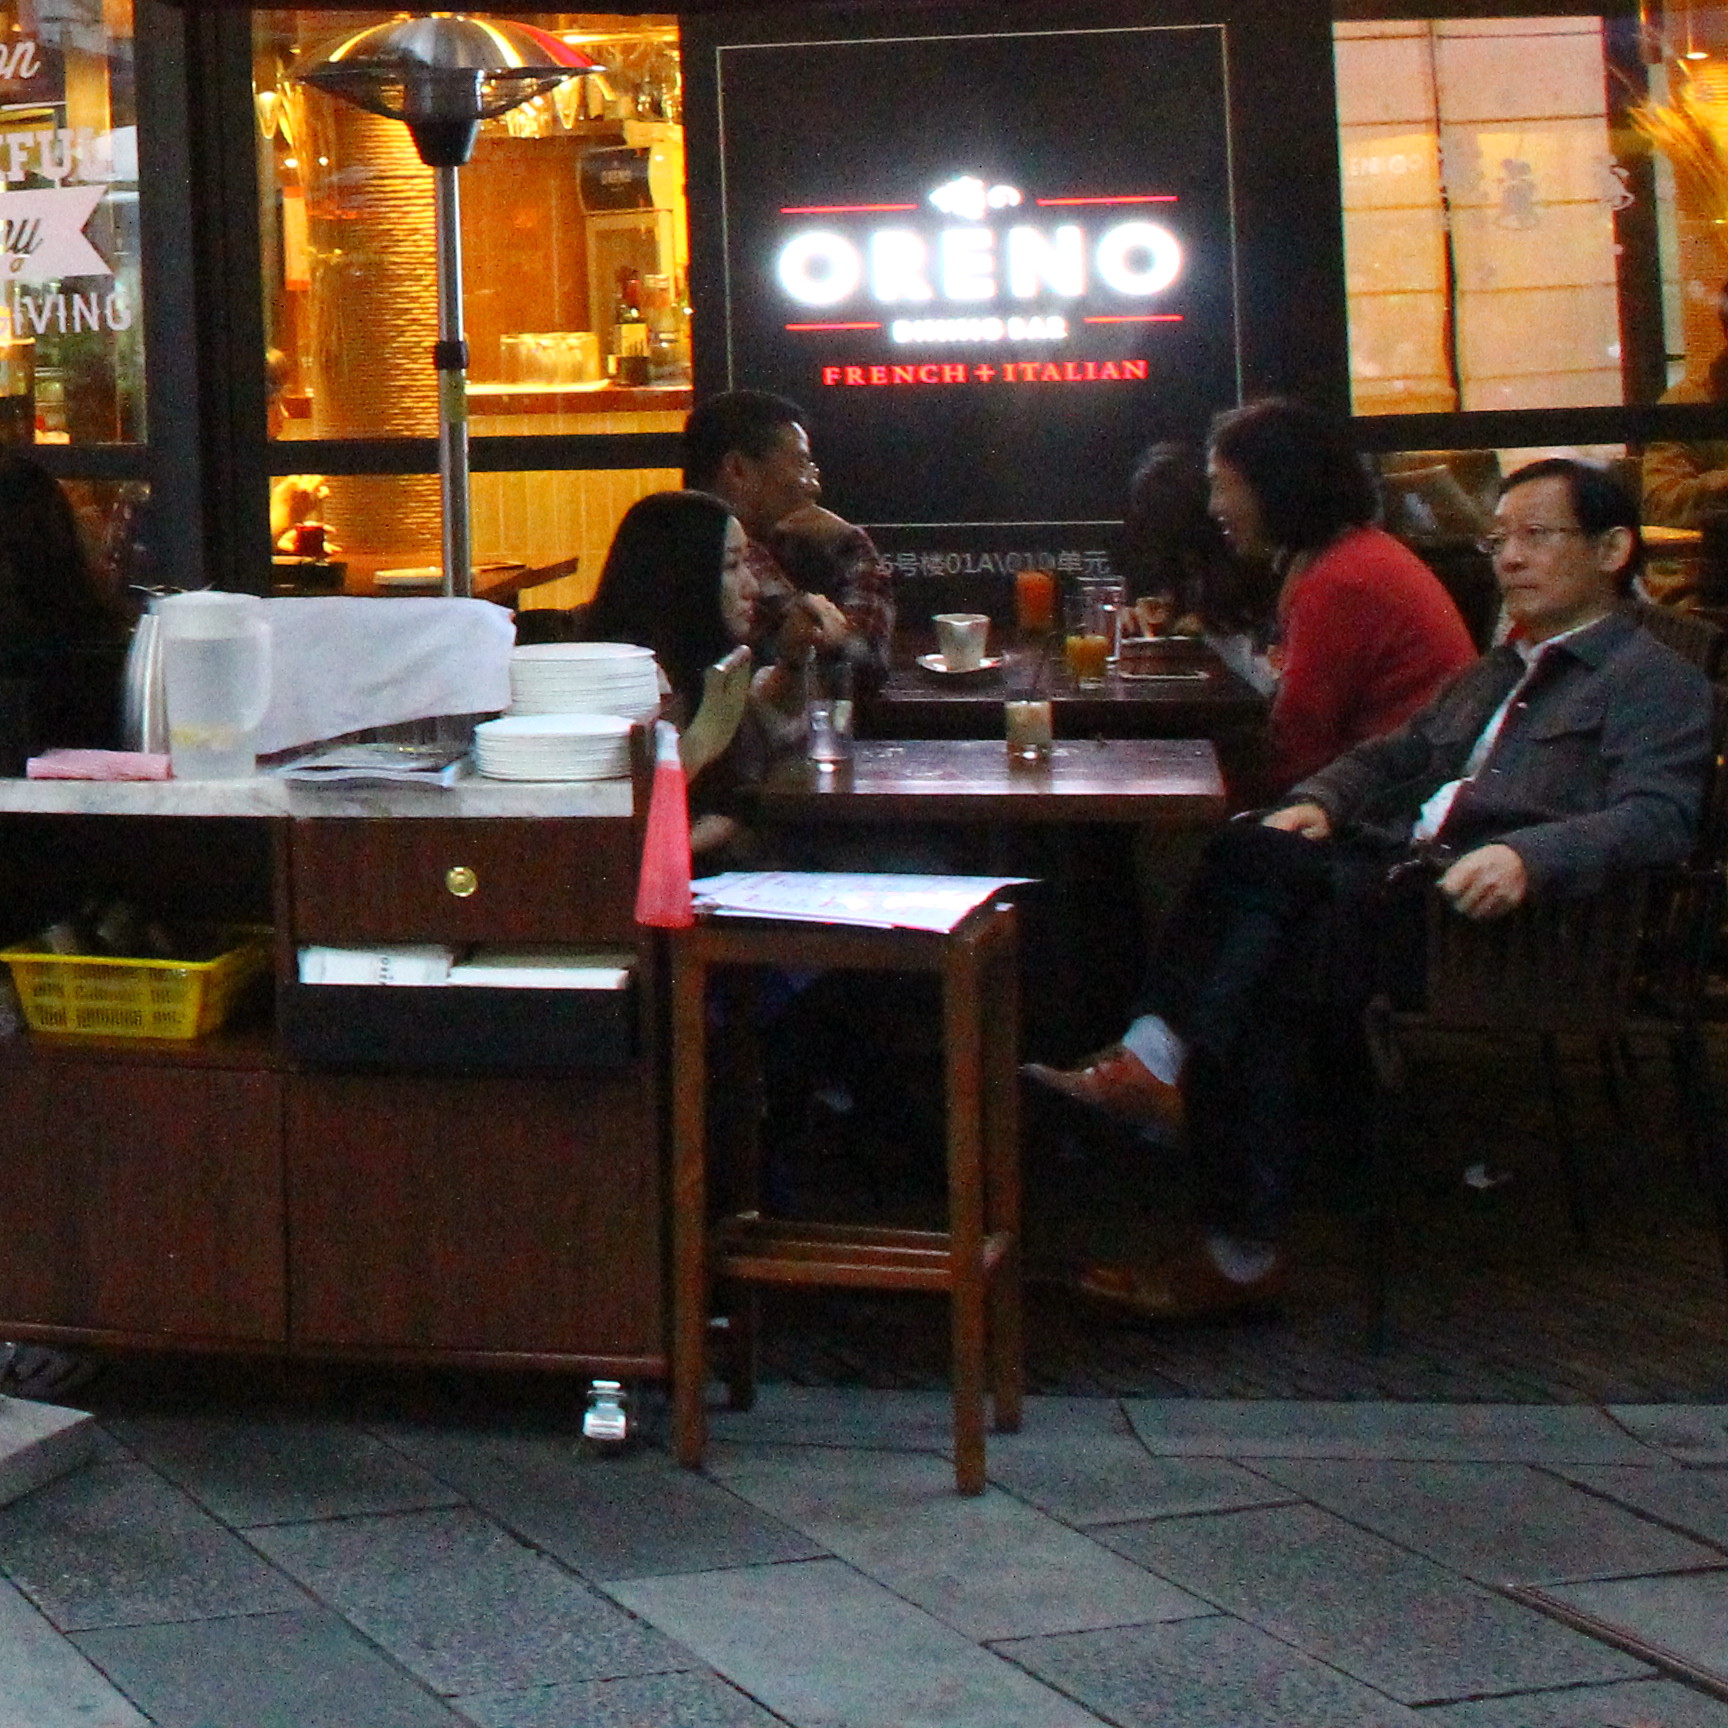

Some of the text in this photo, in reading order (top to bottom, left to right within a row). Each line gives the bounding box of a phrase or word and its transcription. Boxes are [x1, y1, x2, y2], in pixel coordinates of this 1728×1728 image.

[775, 219, 1182, 308] ORENO
[823, 363, 968, 387] FRENCH
[1002, 359, 1150, 383] ITALIAN
